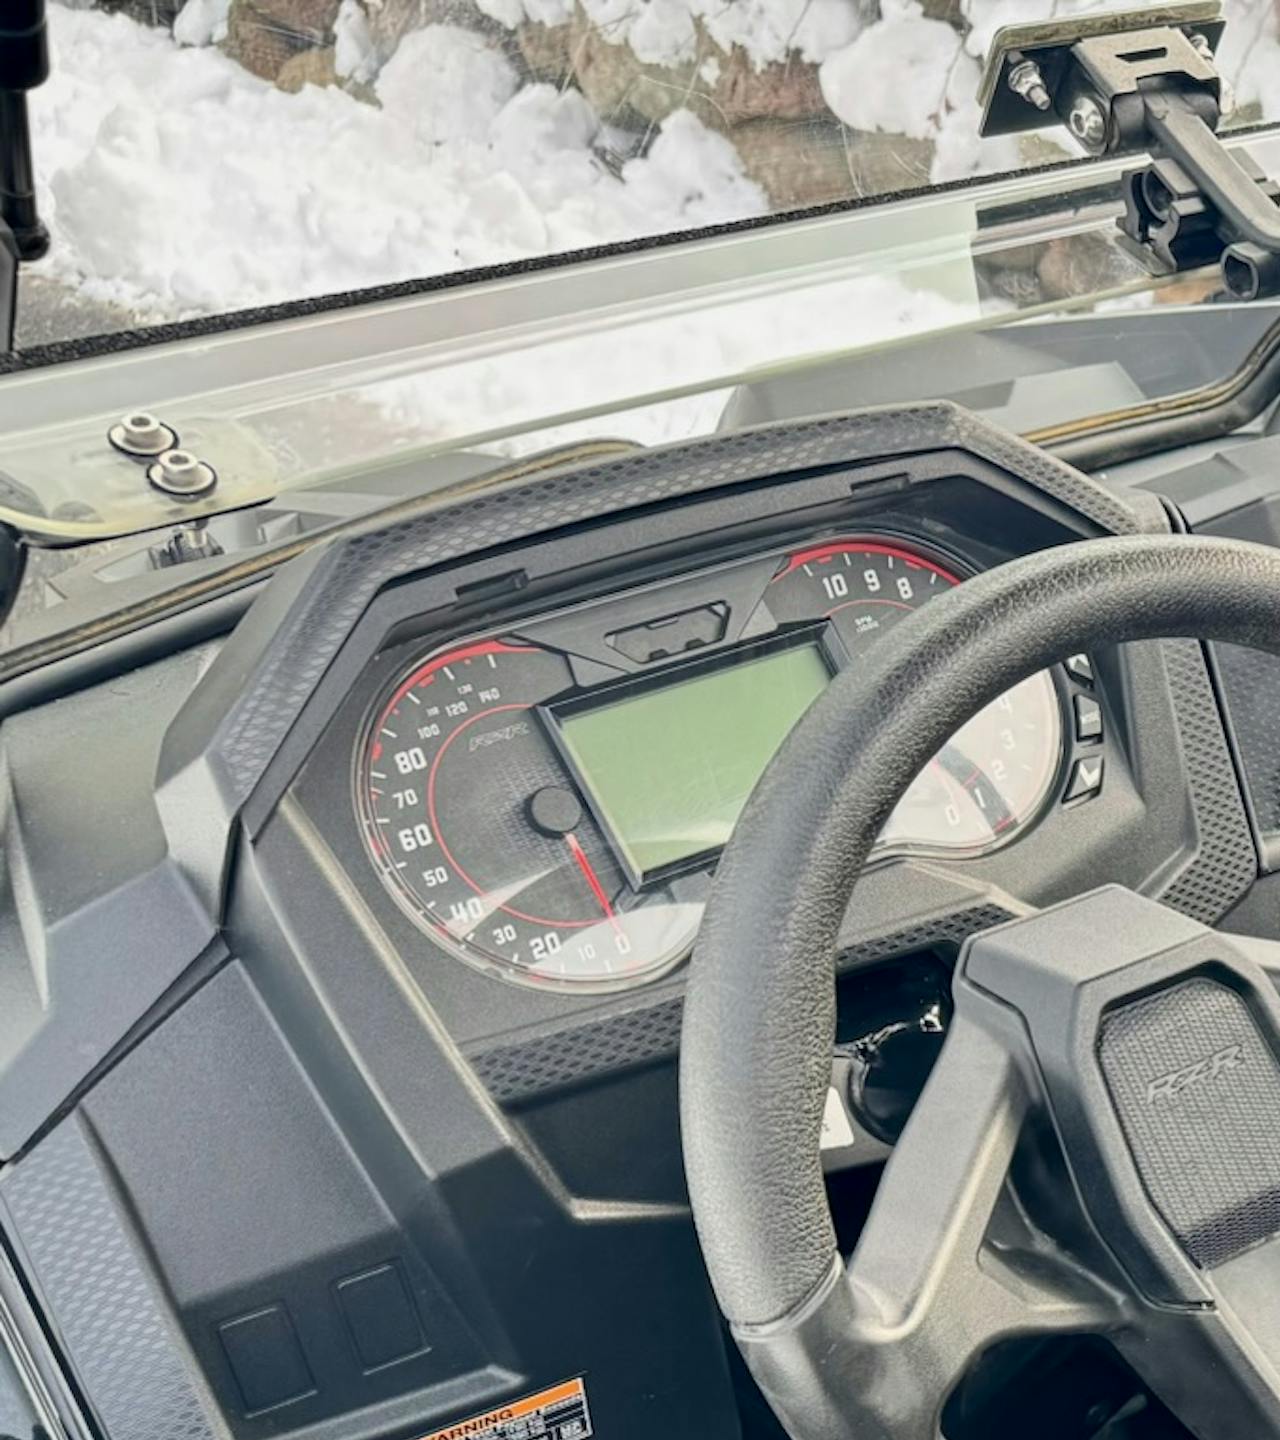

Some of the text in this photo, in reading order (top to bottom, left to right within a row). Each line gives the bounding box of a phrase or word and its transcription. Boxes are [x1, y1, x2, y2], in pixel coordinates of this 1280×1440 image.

[822, 573, 849, 600] 10
[863, 569, 881, 592] 9
[896, 577, 914, 600] 8
[478, 687, 500, 703] 140
[445, 701, 469, 717] 120
[417, 723, 440, 739] 100
[1001, 729, 1016, 750] 3
[394, 747, 427, 775] 80
[992, 758, 1008, 781] 2
[392, 788, 419, 809] 70
[975, 788, 986, 808] 1
[944, 804, 961, 826] 0
[398, 824, 434, 852] 60
[422, 867, 449, 887] 50
[449, 897, 483, 924] 40
[492, 924, 517, 945] 30
[614, 932, 632, 955] 0
[529, 932, 562, 960] 20
[577, 943, 596, 962] 10
